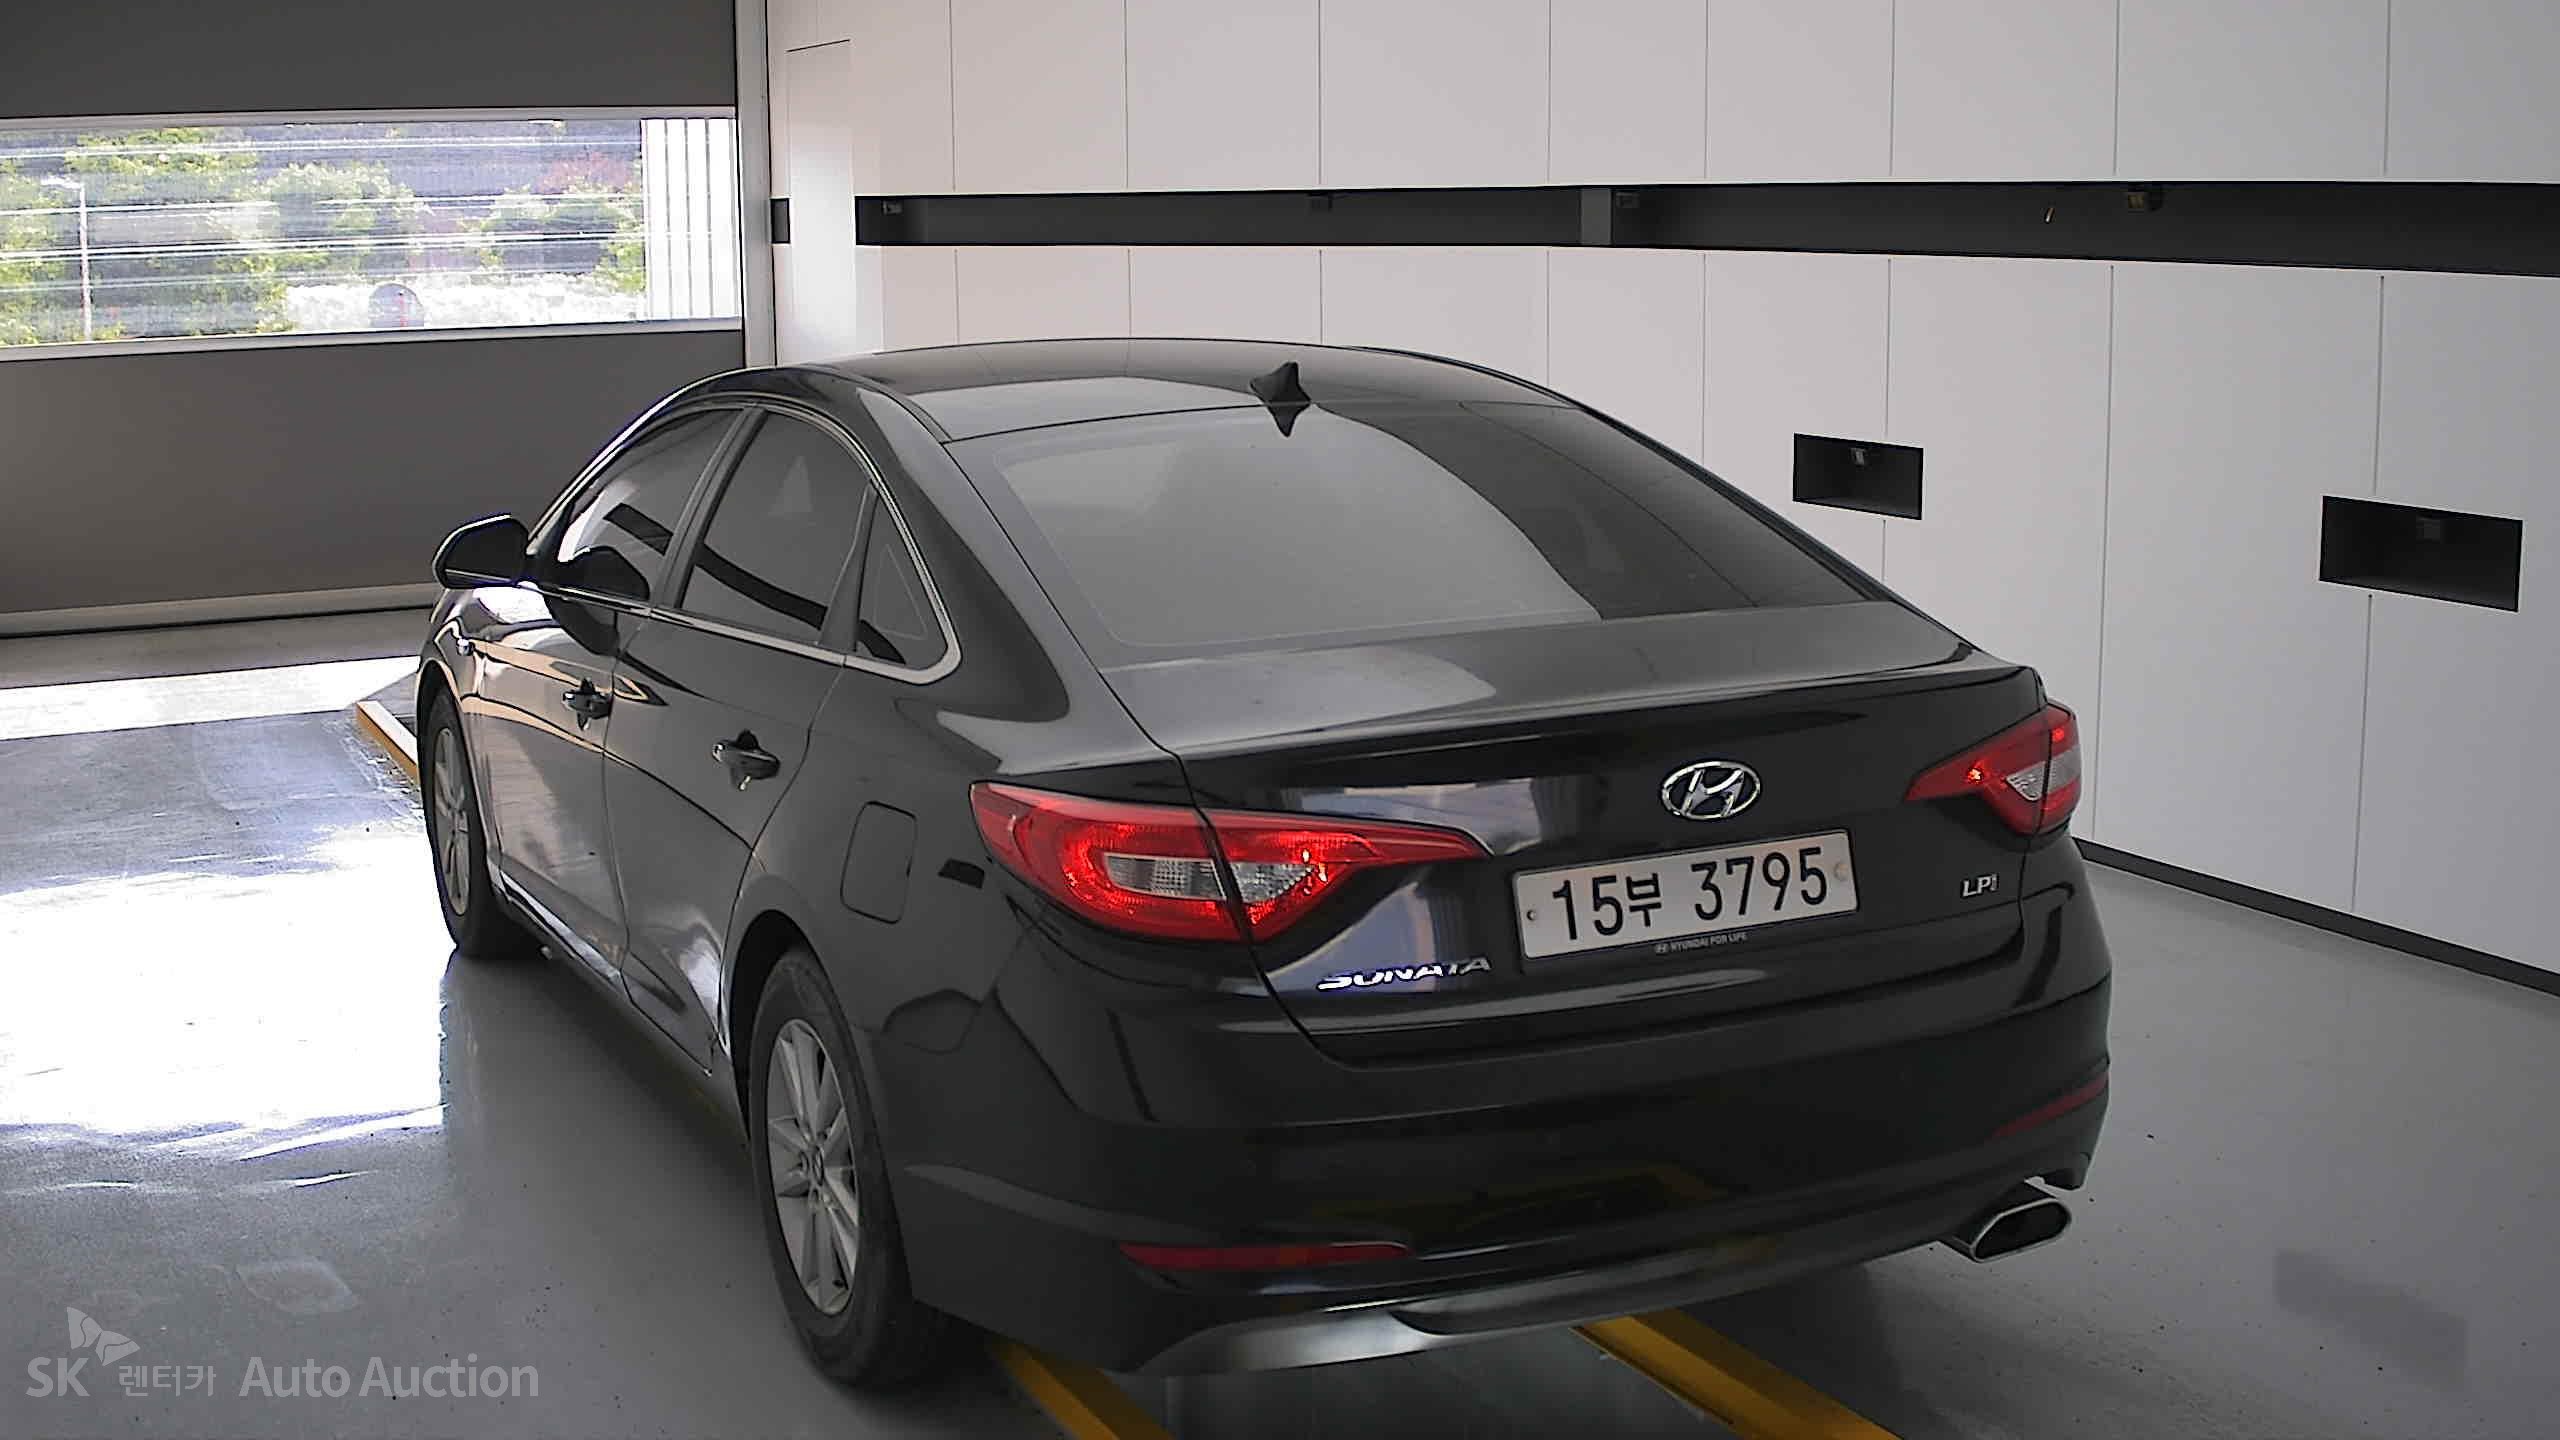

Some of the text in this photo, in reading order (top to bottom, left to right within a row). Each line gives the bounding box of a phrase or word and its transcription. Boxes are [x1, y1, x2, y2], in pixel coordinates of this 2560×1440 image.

[1552, 847, 1828, 940] 15부 3795
[1316, 957, 1492, 990] SONATA
